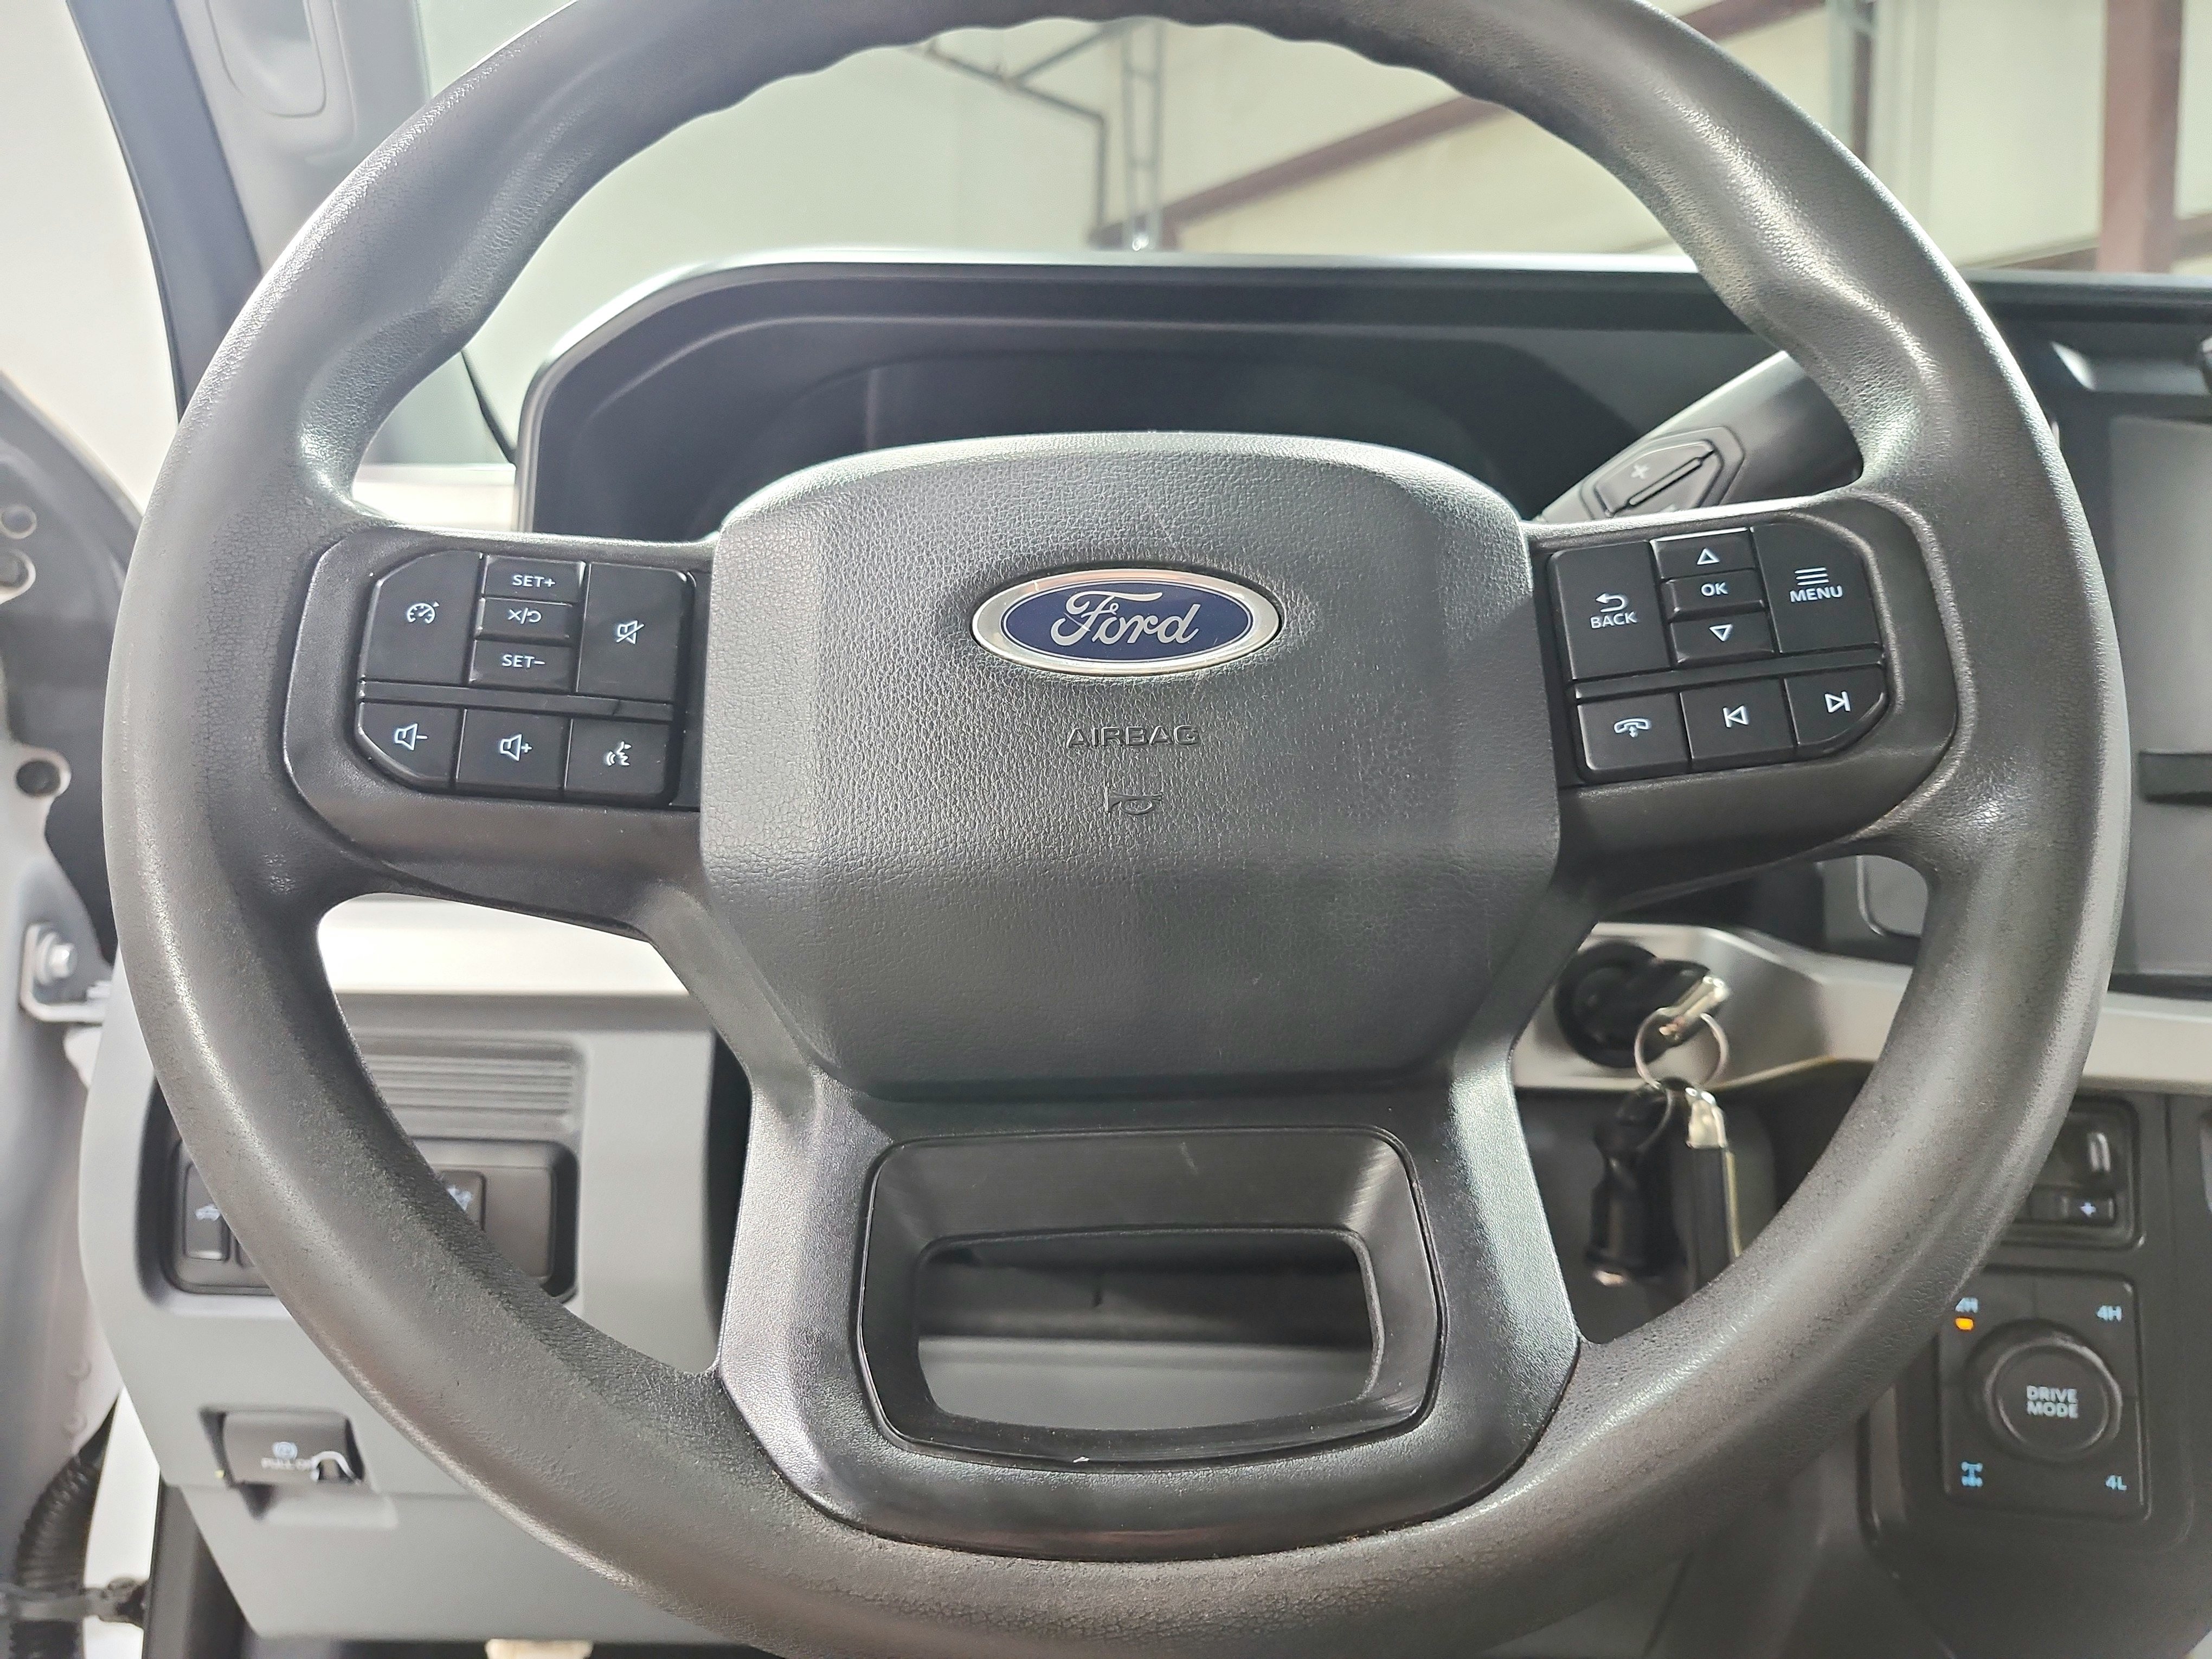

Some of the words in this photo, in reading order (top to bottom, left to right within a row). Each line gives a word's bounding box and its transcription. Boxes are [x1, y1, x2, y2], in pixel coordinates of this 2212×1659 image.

[512, 574, 556, 589] SET+
[1701, 582, 1728, 597] OK
[1790, 584, 1843, 603] MENU
[1050, 590, 1201, 646] Ford
[1590, 610, 1637, 629] BACK
[1064, 724, 1200, 749] AIRBAG
[2097, 1304, 2123, 1322] 4H
[2026, 1385, 2078, 1403] DRIVE
[2026, 1400, 2079, 1419] MODE
[2105, 1474, 2127, 1491] 4L
